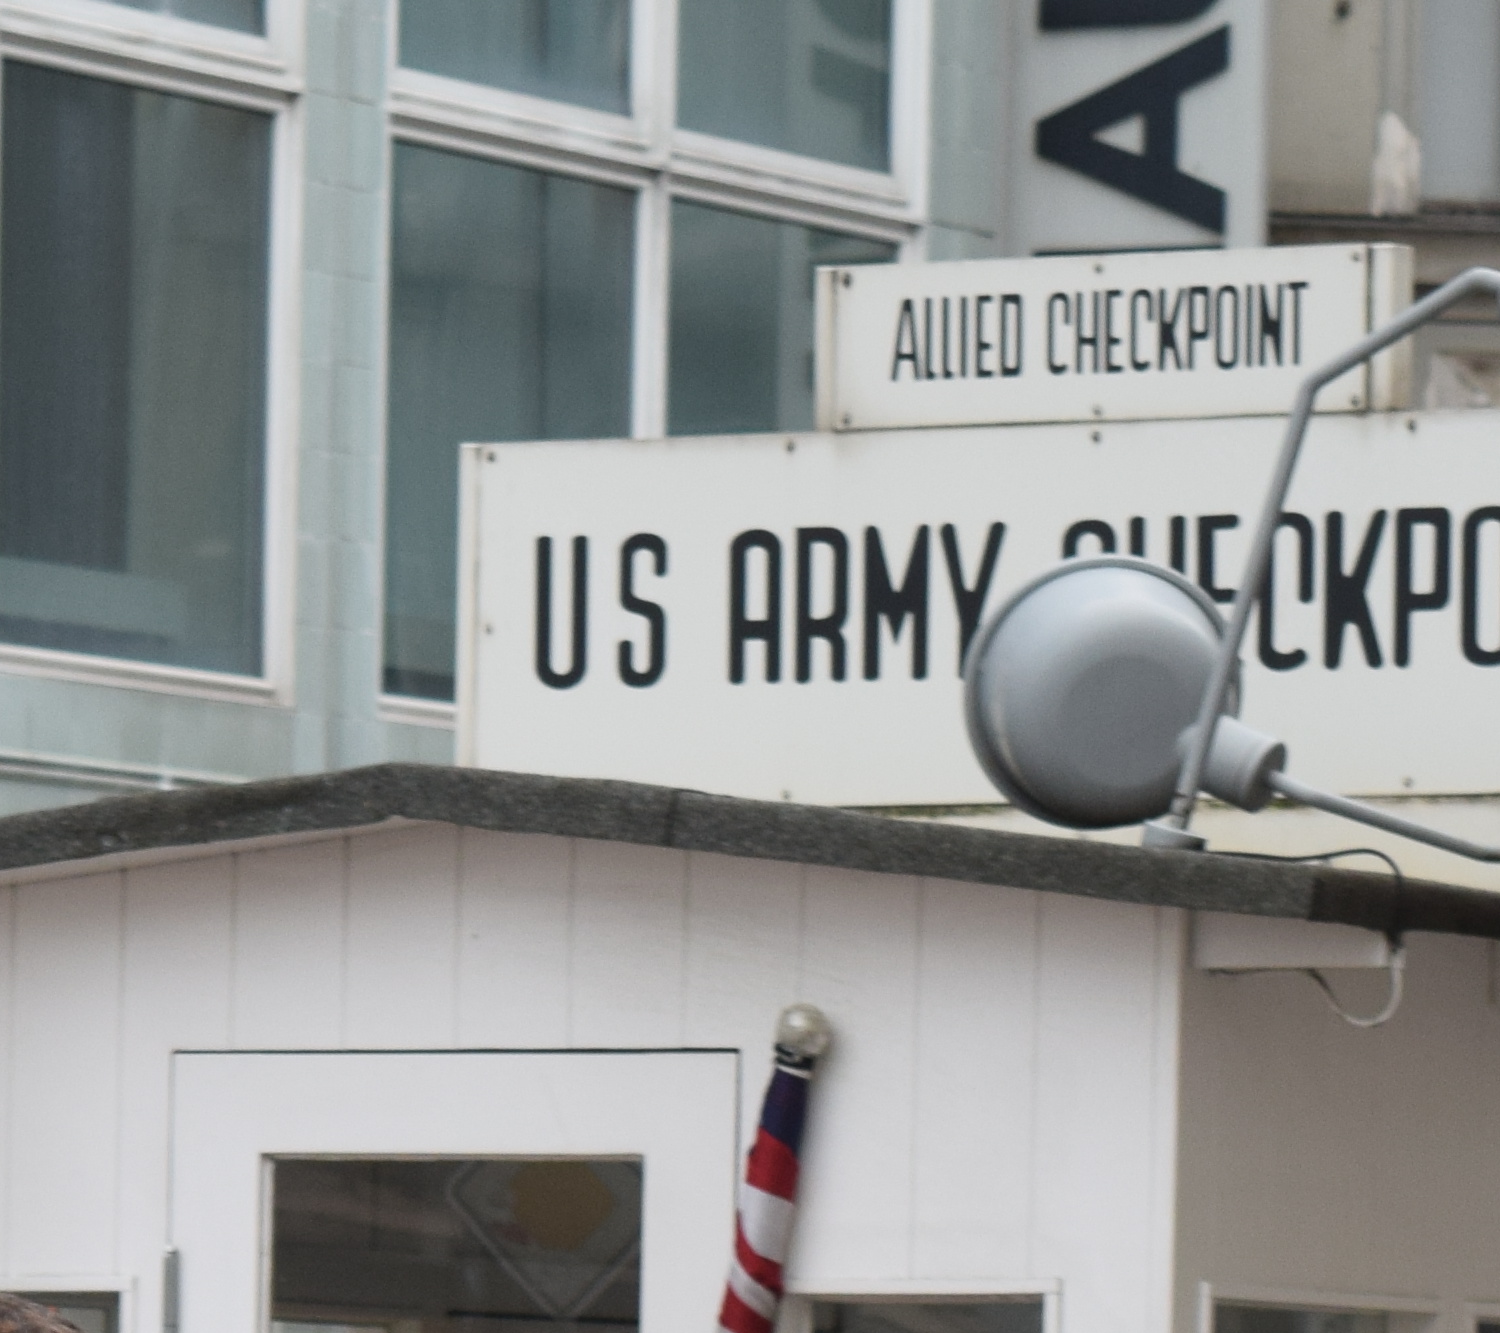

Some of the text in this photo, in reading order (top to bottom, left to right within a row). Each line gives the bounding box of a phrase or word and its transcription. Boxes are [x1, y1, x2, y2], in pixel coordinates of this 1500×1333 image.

[890, 281, 1311, 382] ALLIED CHECKPOINT
[728, 522, 1007, 682] ARMY
